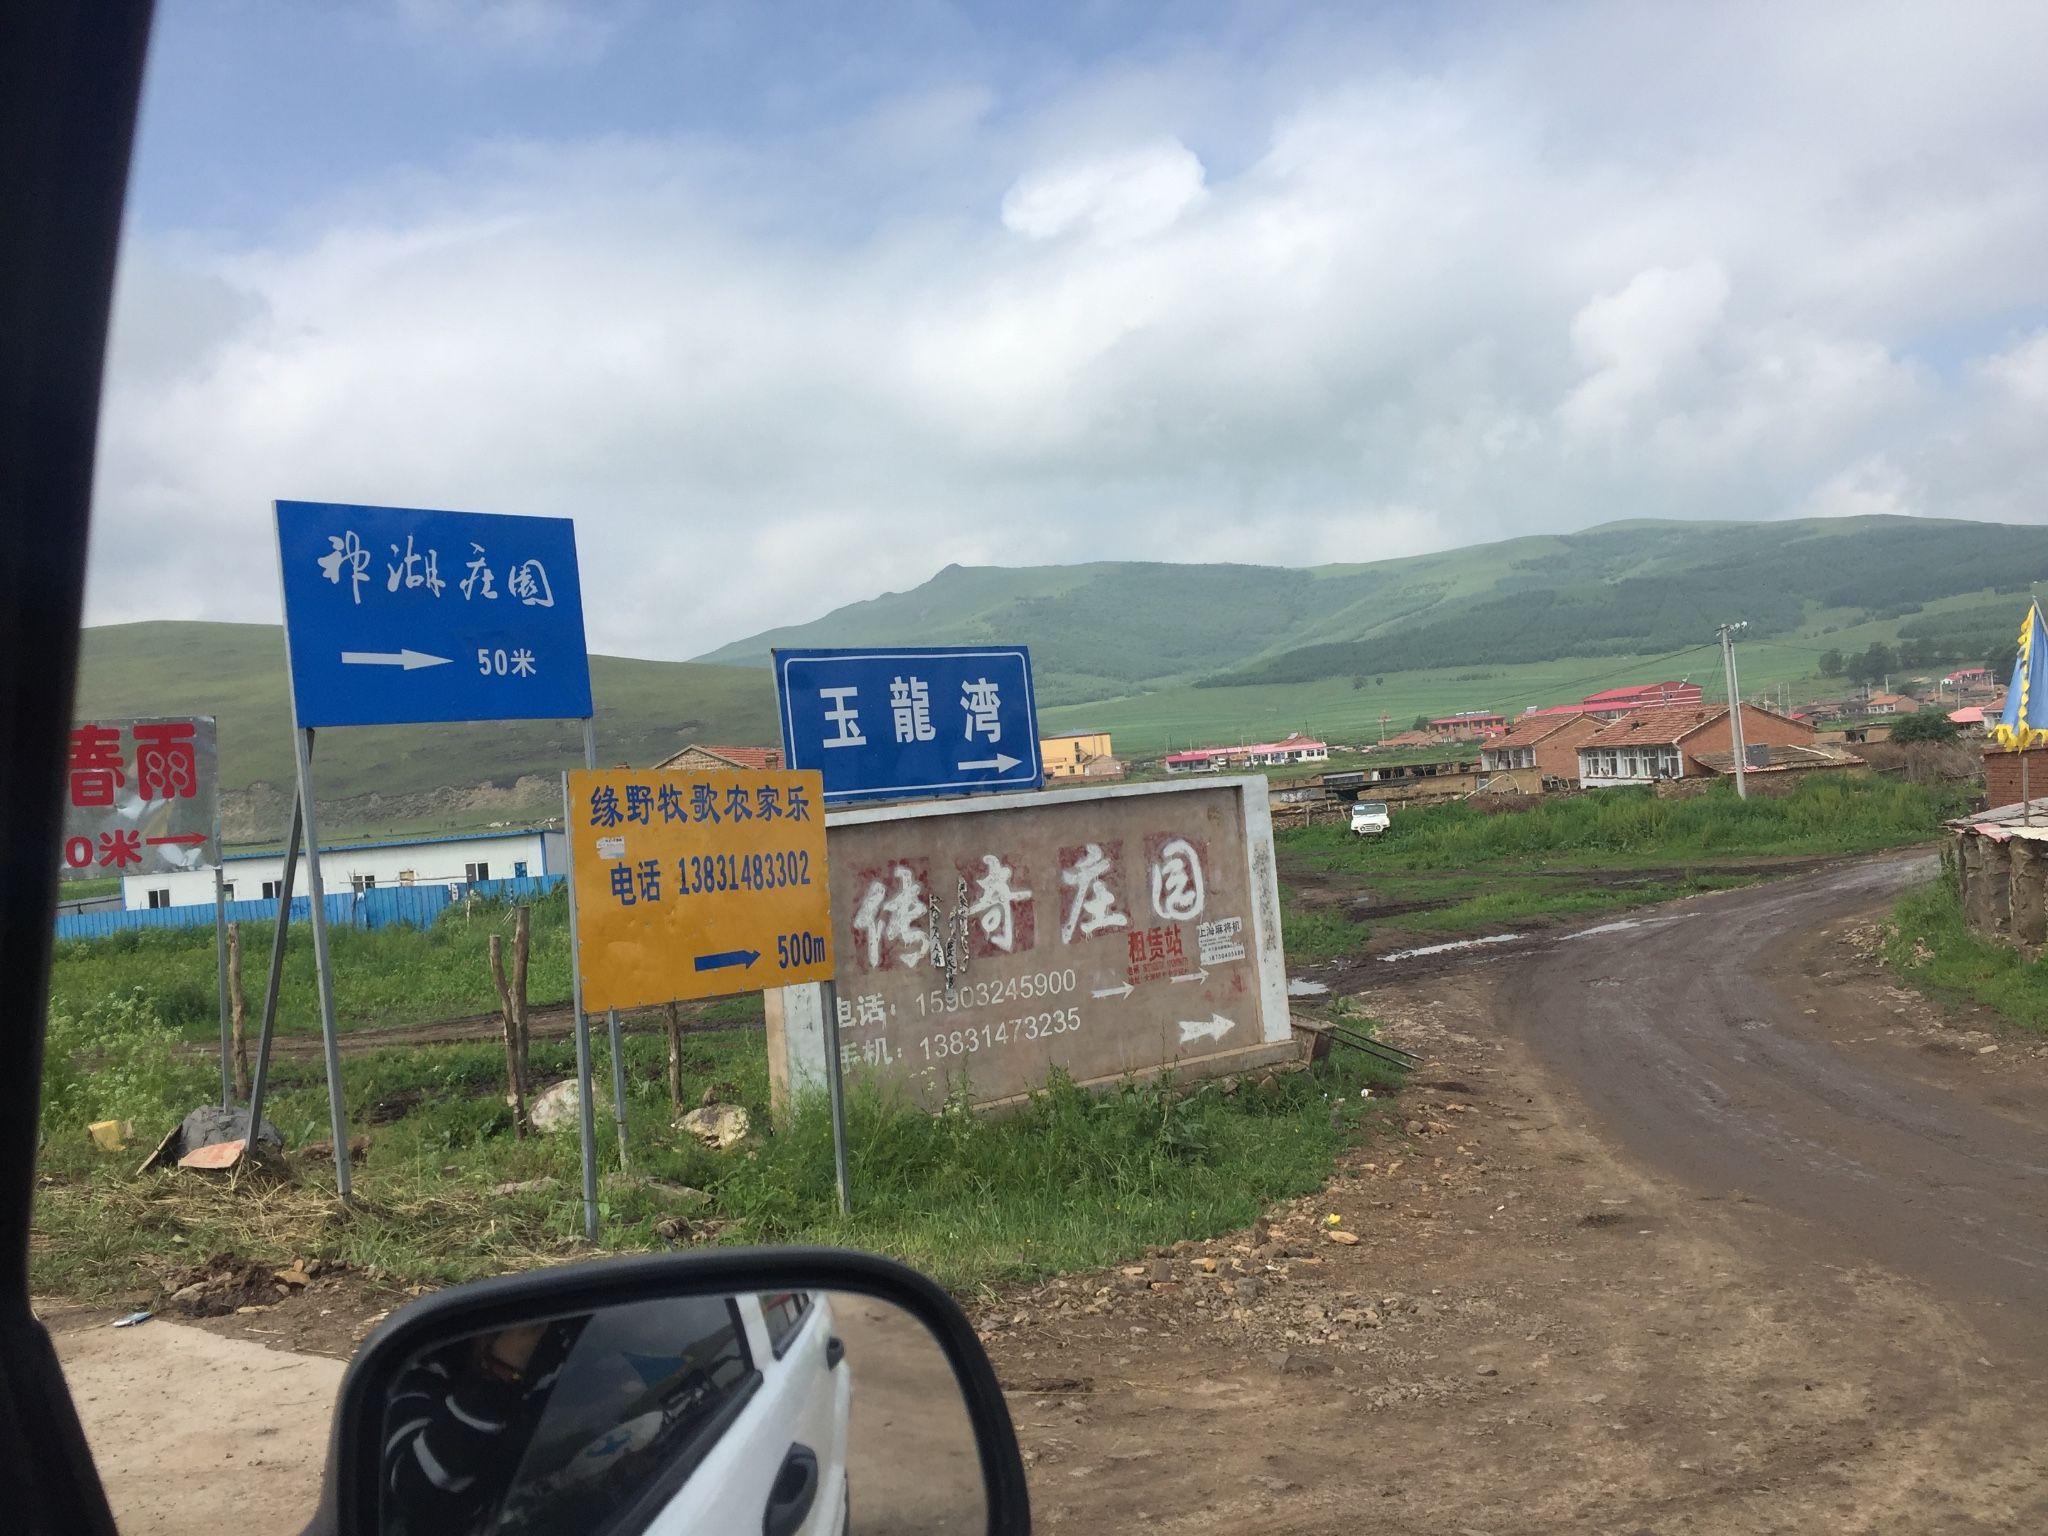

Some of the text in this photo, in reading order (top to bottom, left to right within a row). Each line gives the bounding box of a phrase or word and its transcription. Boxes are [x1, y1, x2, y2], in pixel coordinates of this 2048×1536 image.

[477, 648, 537, 678] 50米
[819, 676, 1001, 748] 玉龍湾
[590, 782, 811, 828] 缘野牧歌农家乐
[610, 850, 811, 906] 电话 13831483302
[777, 931, 826, 969] 500m
[1128, 923, 1184, 964] 租赁站
[915, 968, 1077, 1017] 15903245900
[919, 1006, 1082, 1060] 13831473235
